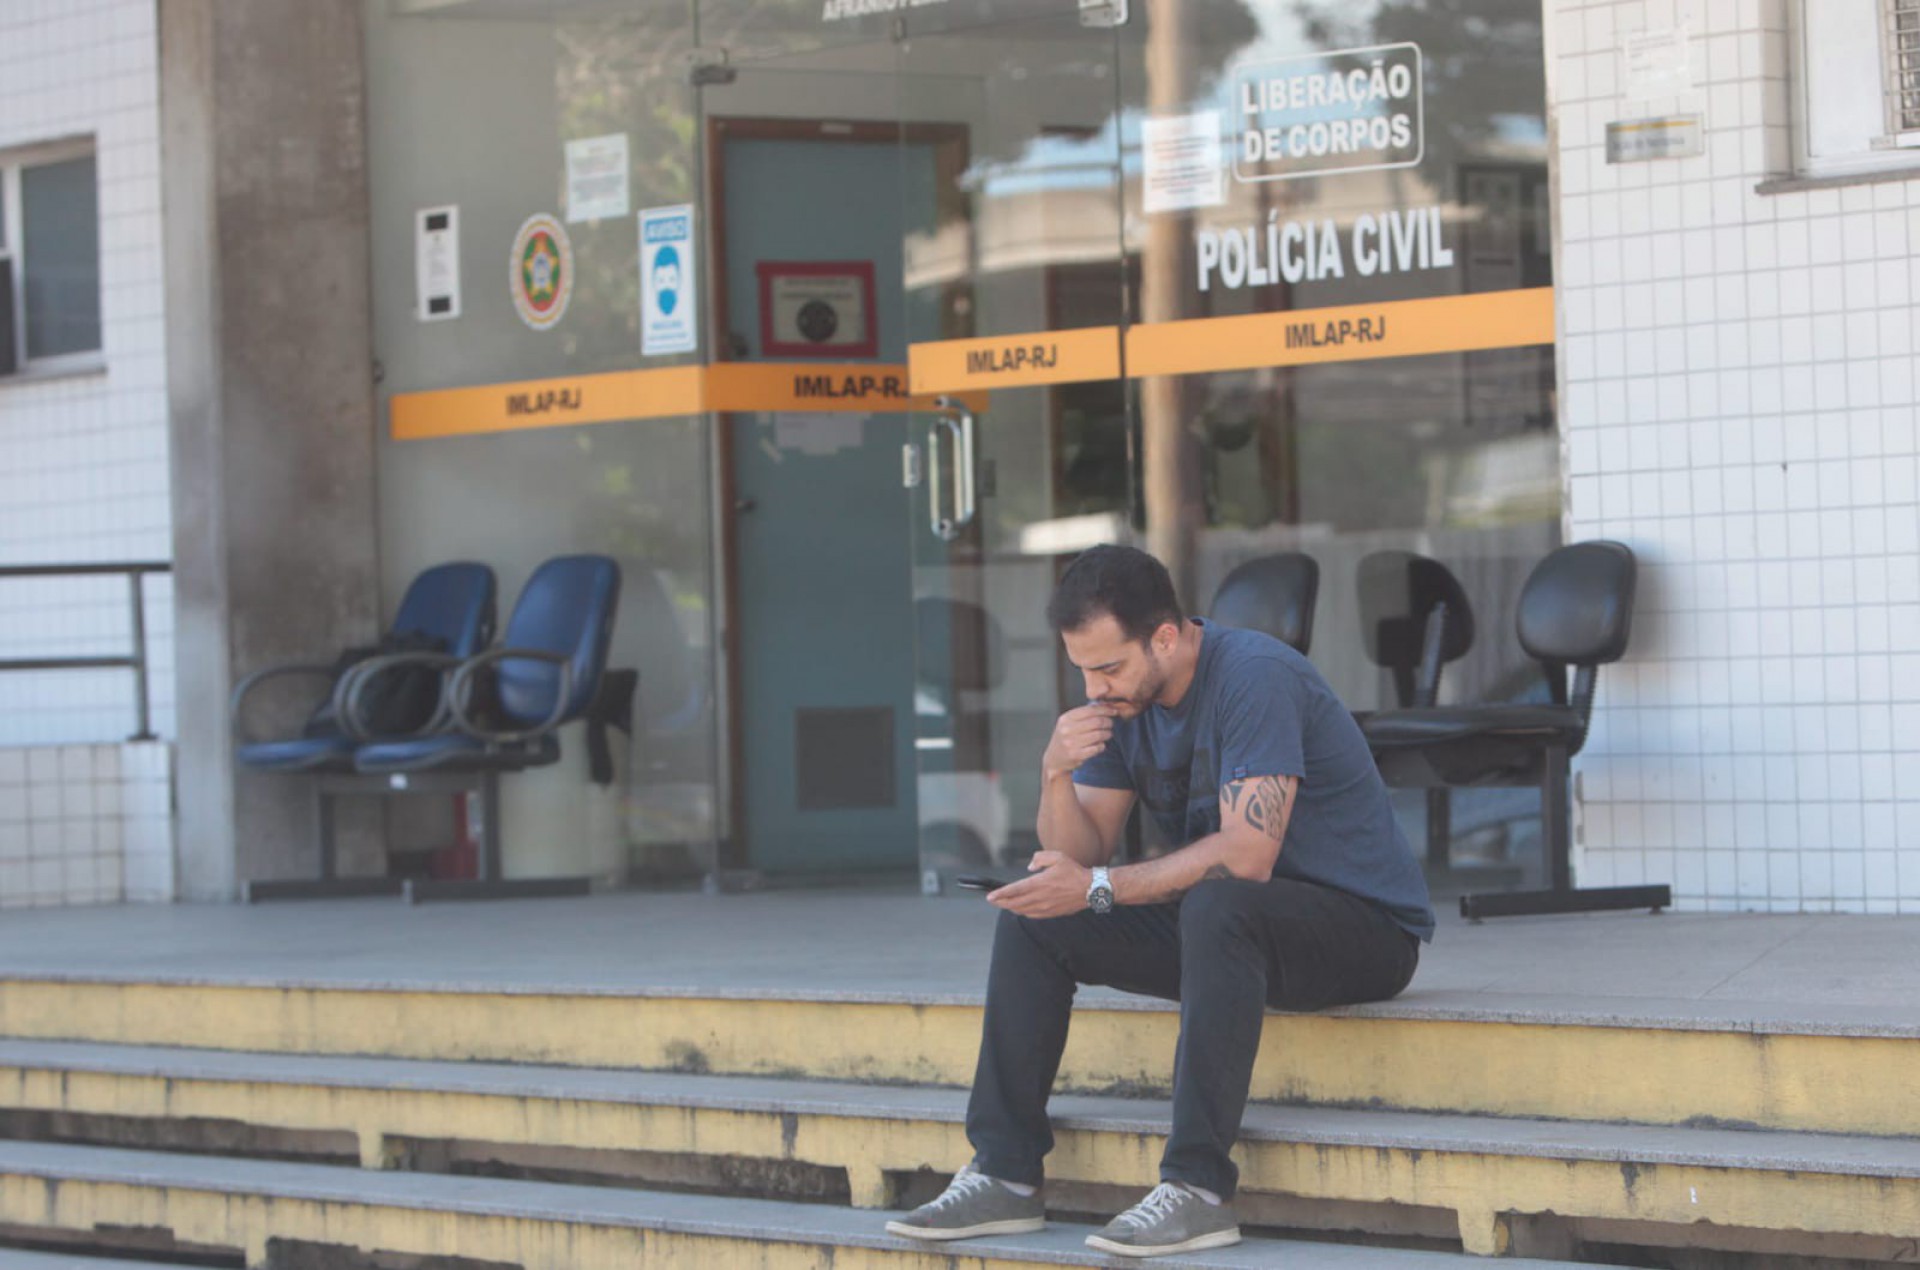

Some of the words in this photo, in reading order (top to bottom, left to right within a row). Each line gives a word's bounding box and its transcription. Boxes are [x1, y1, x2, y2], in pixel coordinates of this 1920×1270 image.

[1242, 60, 1411, 114] LIBERAÇÃO
[1245, 129, 1281, 162] DE
[1289, 114, 1411, 158] CORPOS
[1197, 208, 1344, 291] POLÍCIA
[1353, 206, 1453, 276] CIVIL
[1285, 315, 1385, 349] IMLAP-RJ
[966, 344, 1057, 374] IMLAP-RJ
[506, 387, 581, 416] IMLAP-RJ
